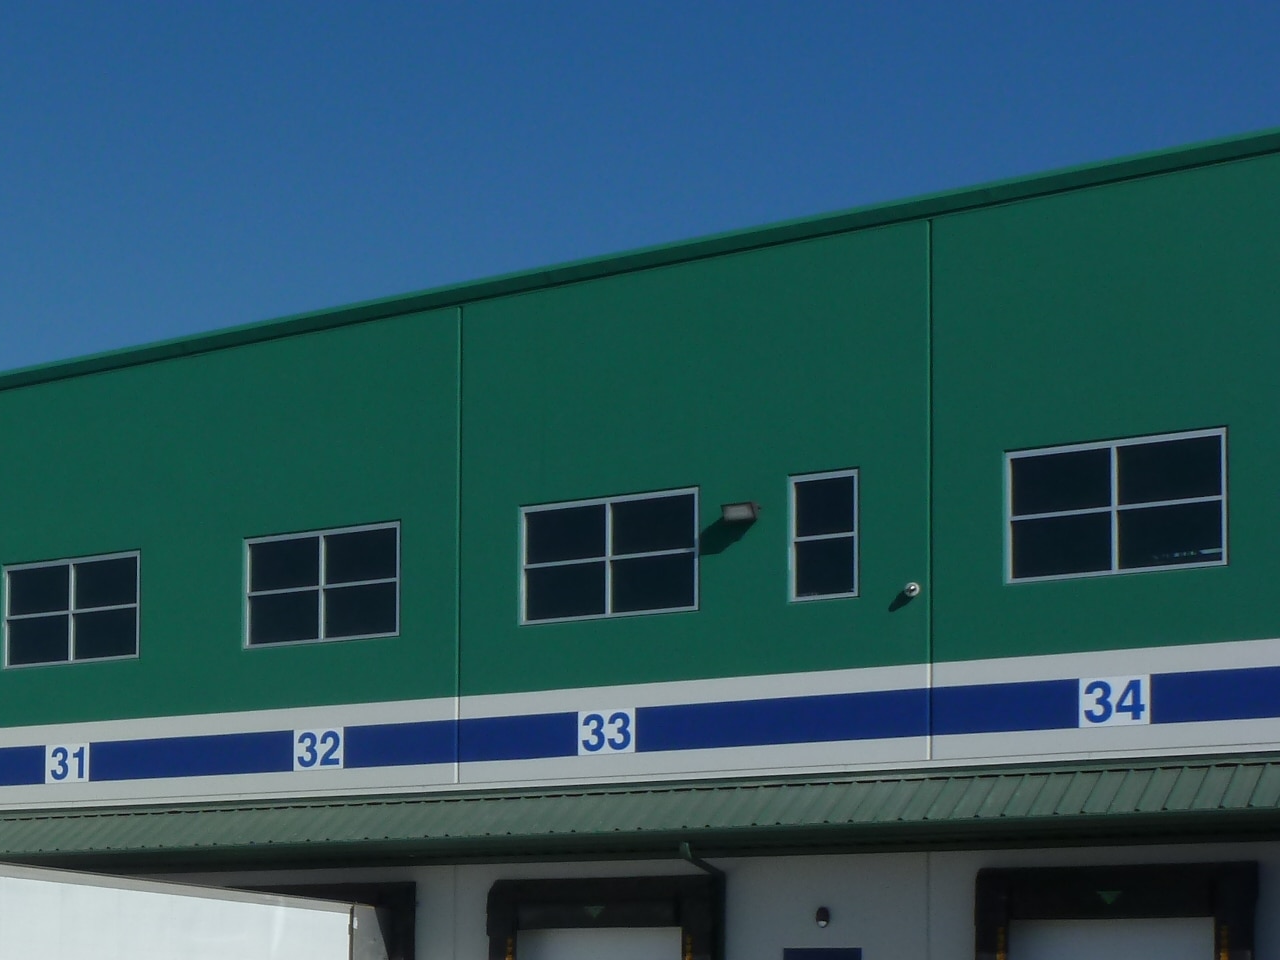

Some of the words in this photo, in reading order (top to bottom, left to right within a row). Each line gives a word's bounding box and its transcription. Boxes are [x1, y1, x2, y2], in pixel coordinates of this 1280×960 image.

[1084, 679, 1145, 723] 34
[297, 730, 340, 767] 32
[580, 711, 631, 752] 33
[51, 746, 85, 781] 31
